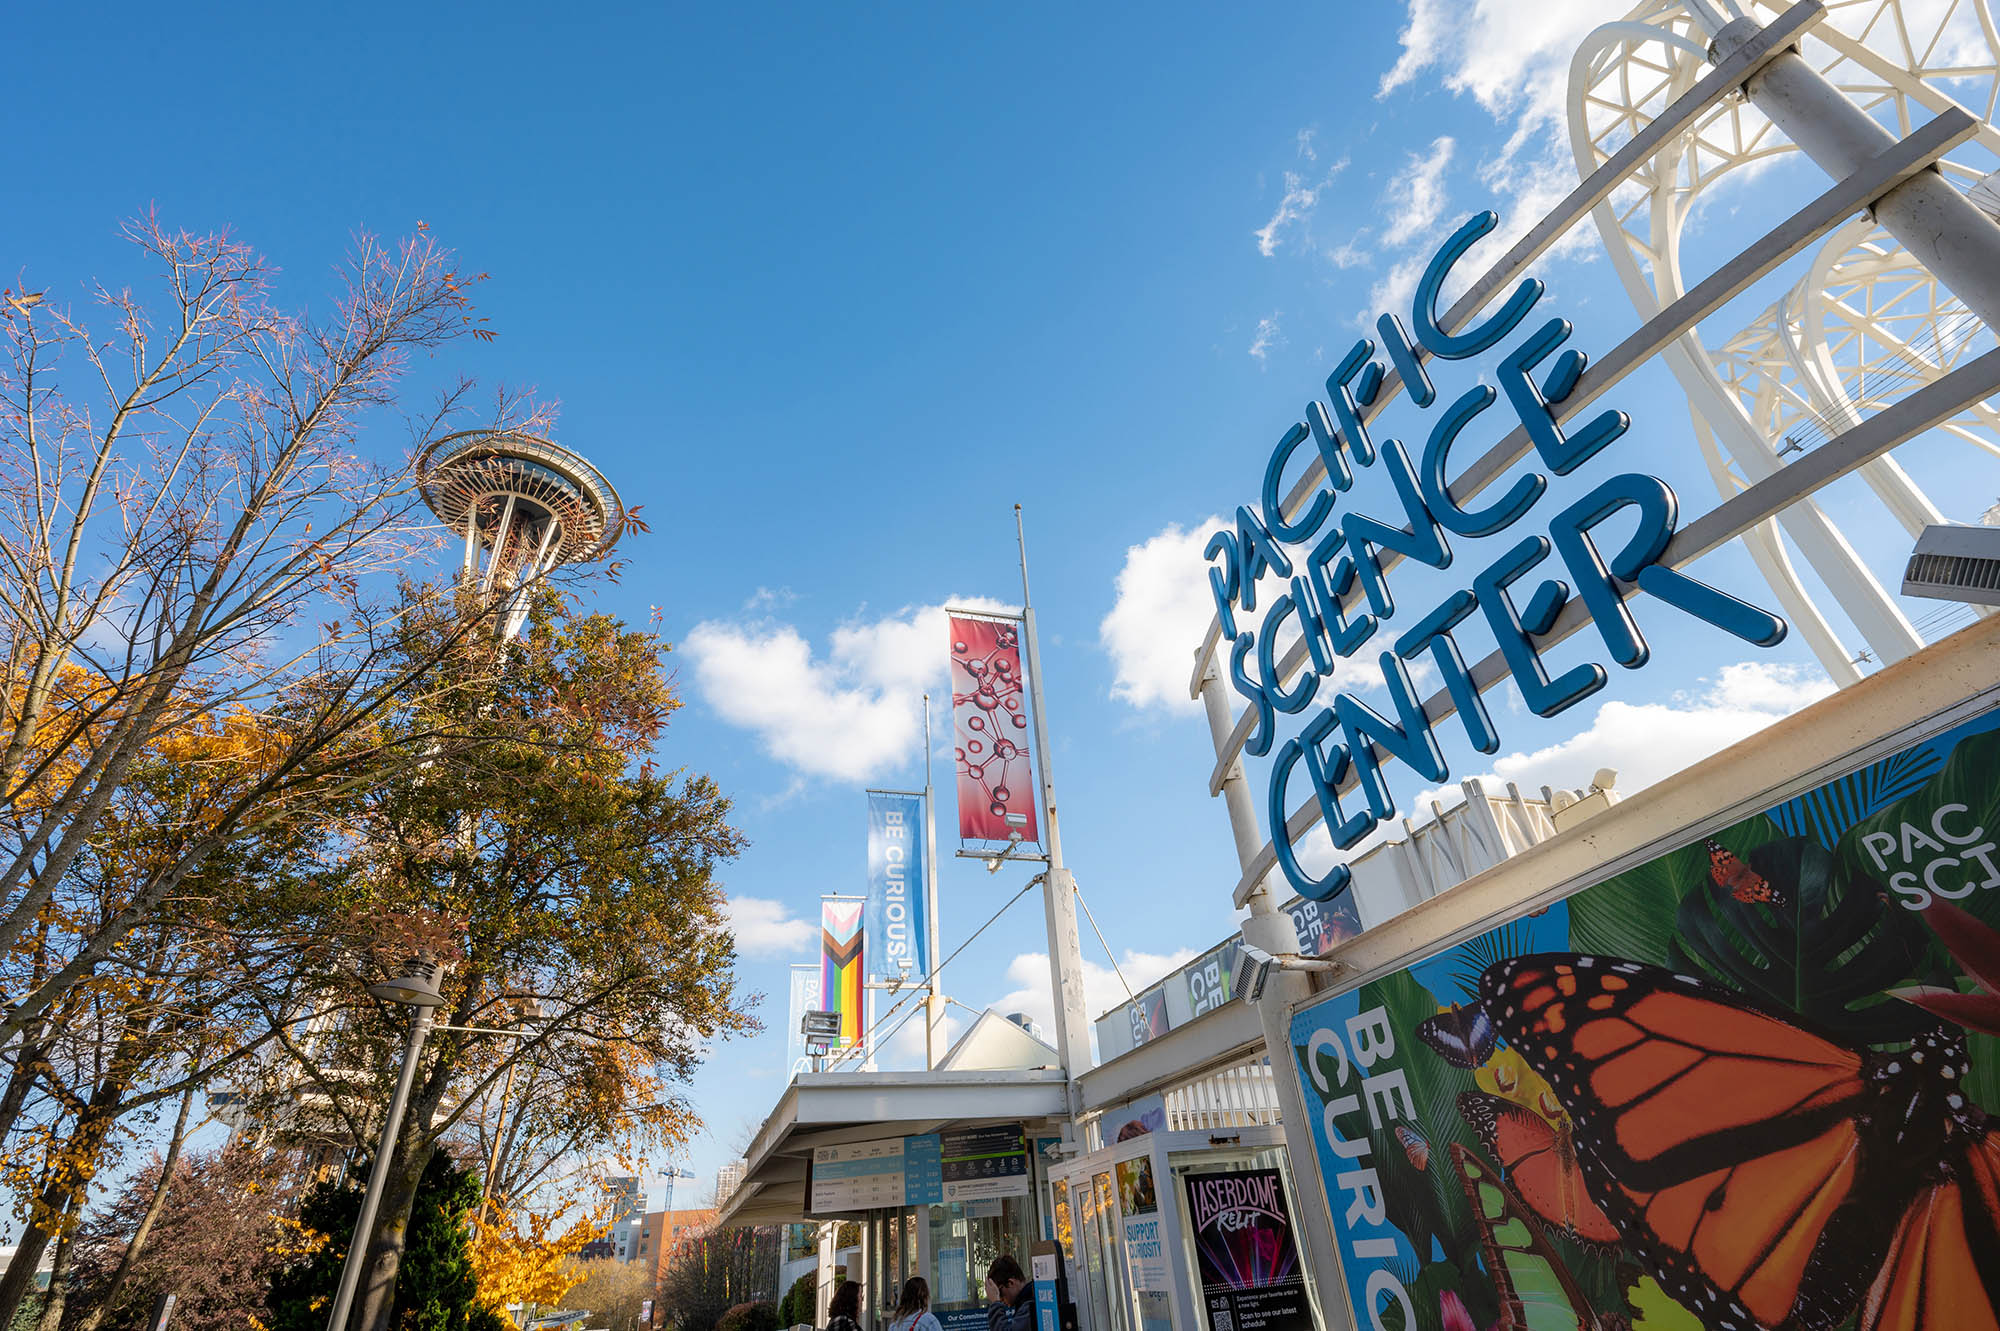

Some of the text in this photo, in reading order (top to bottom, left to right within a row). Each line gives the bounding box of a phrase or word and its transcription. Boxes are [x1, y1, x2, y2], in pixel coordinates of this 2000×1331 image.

[1204, 210, 1545, 641] PACIFIC
[1230, 316, 1631, 758] SCIENCE
[1268, 472, 1788, 903] CENTER
[1861, 803, 1984, 872] PAC
[885, 811, 907, 964] BE CURIOUS.
[1889, 842, 2000, 912] SCI
[1291, 910, 1315, 957] CU
[1302, 900, 1324, 940] BE
[1203, 960, 1225, 1010] BE
[1130, 1007, 1143, 1047] CU
[1345, 1004, 1418, 1131] BE
[1190, 1175, 1287, 1234] LASERDOME
[1307, 1028, 1419, 1331] CURIO
[1126, 1221, 1159, 1242] SUPPORT
[1216, 1209, 1261, 1233] RELIT
[1128, 1241, 1162, 1259] CURIOSITY
[947, 1314, 958, 1322] Our
[1239, 1312, 1254, 1320] Scan
[1281, 1307, 1297, 1315] latest
[1241, 1319, 1266, 1329] schedule
